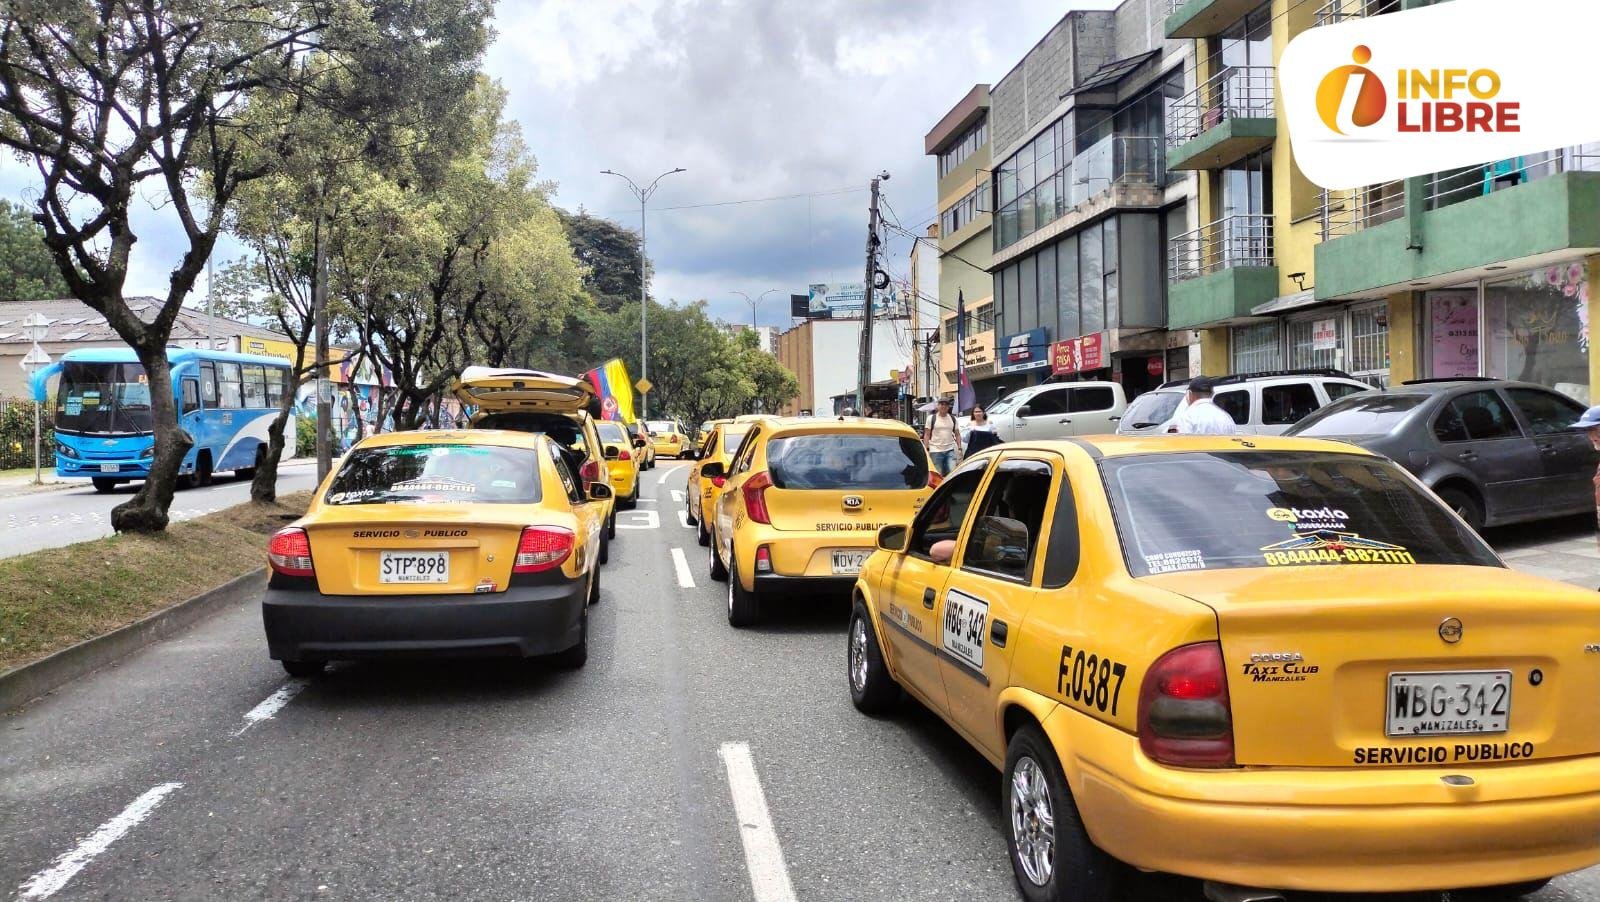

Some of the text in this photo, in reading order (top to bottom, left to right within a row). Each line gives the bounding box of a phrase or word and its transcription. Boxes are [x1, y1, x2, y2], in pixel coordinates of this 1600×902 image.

[1292, 507, 1349, 520] taxia
[816, 523, 888, 532] SERVICIO PUBLIC
[1263, 549, 1417, 566] 8844444-8821111
[1250, 652, 1304, 662] CORSA
[1057, 645, 1127, 716] F.0387
[1420, 719, 1478, 731] MANIZALES
[1353, 742, 1534, 764] SERVICIO PUBLICO
